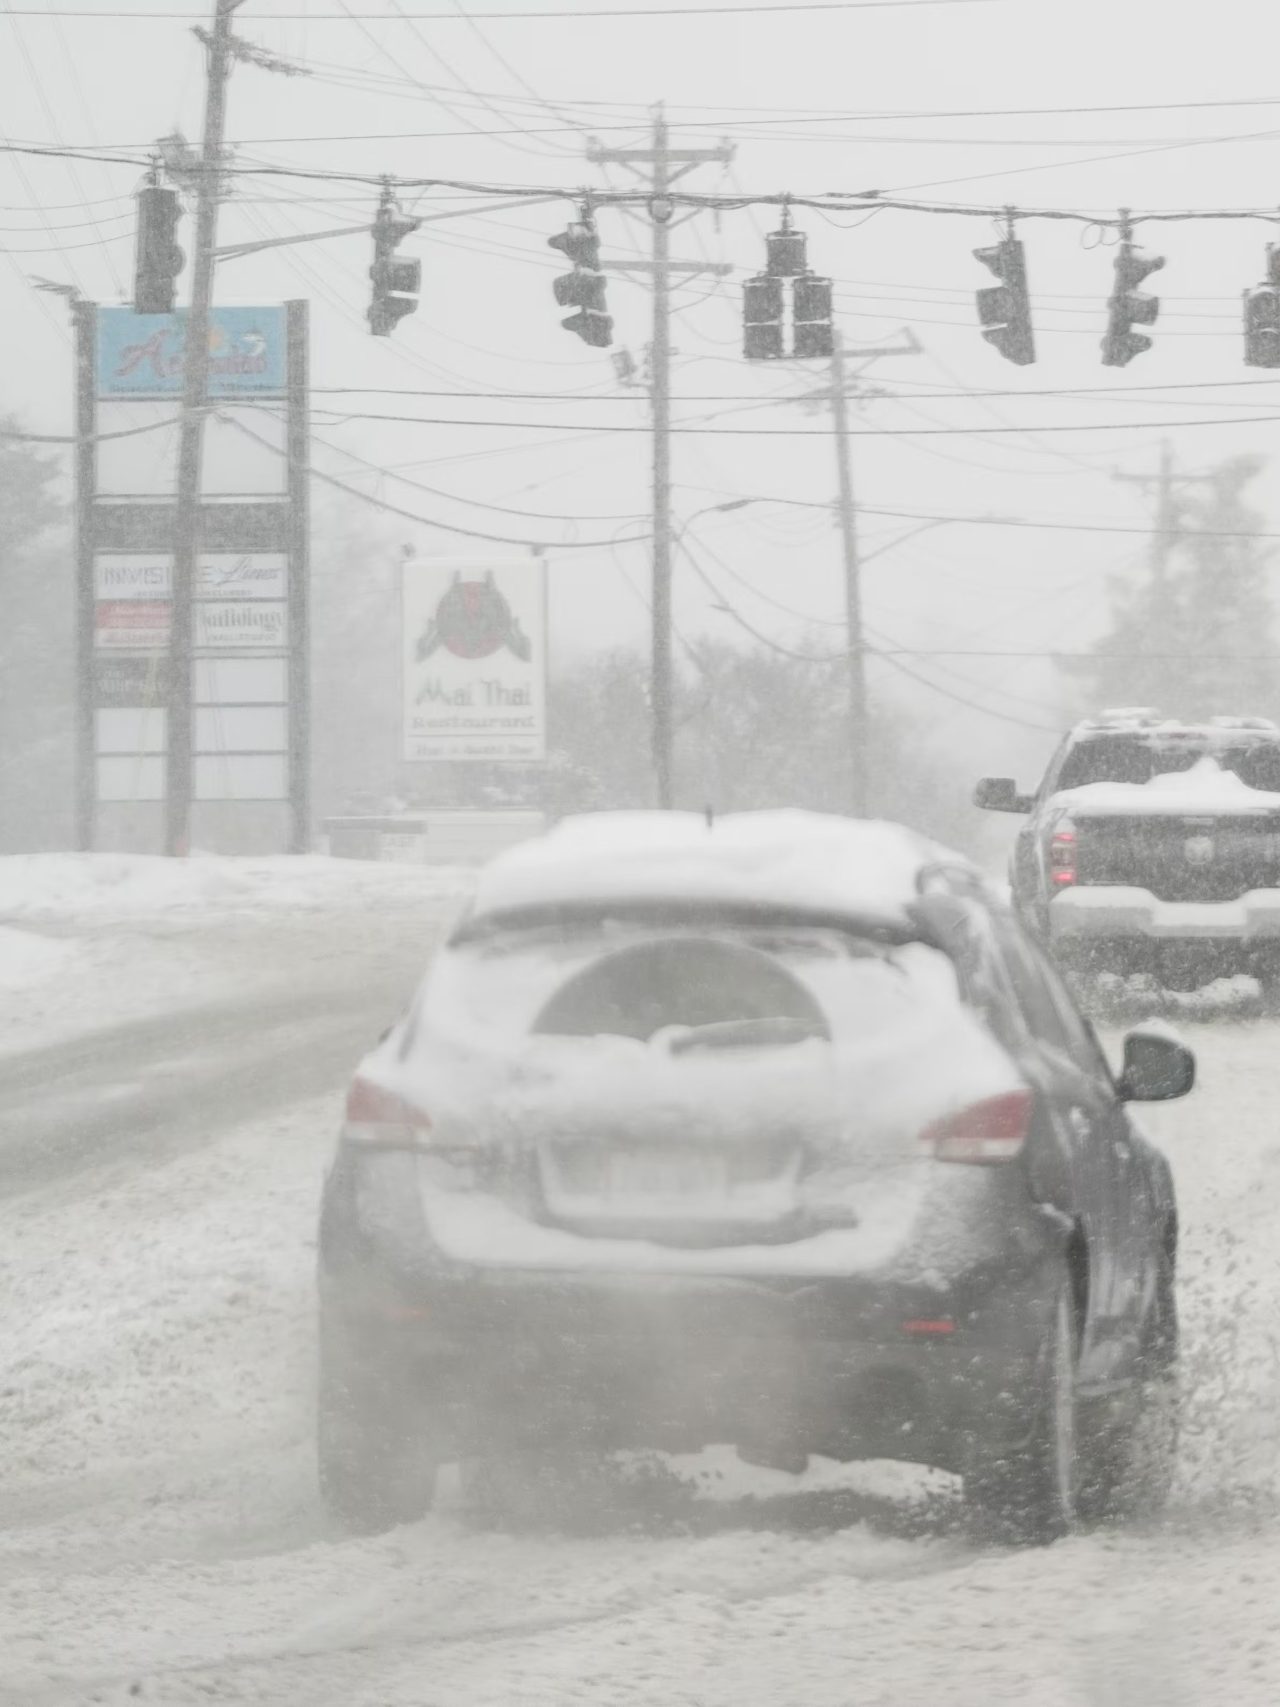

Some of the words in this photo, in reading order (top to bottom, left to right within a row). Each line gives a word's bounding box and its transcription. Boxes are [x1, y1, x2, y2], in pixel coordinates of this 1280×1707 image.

[415, 676, 475, 707] Mai
[480, 678, 534, 707] Thai
[412, 716, 536, 730] Restaurant
